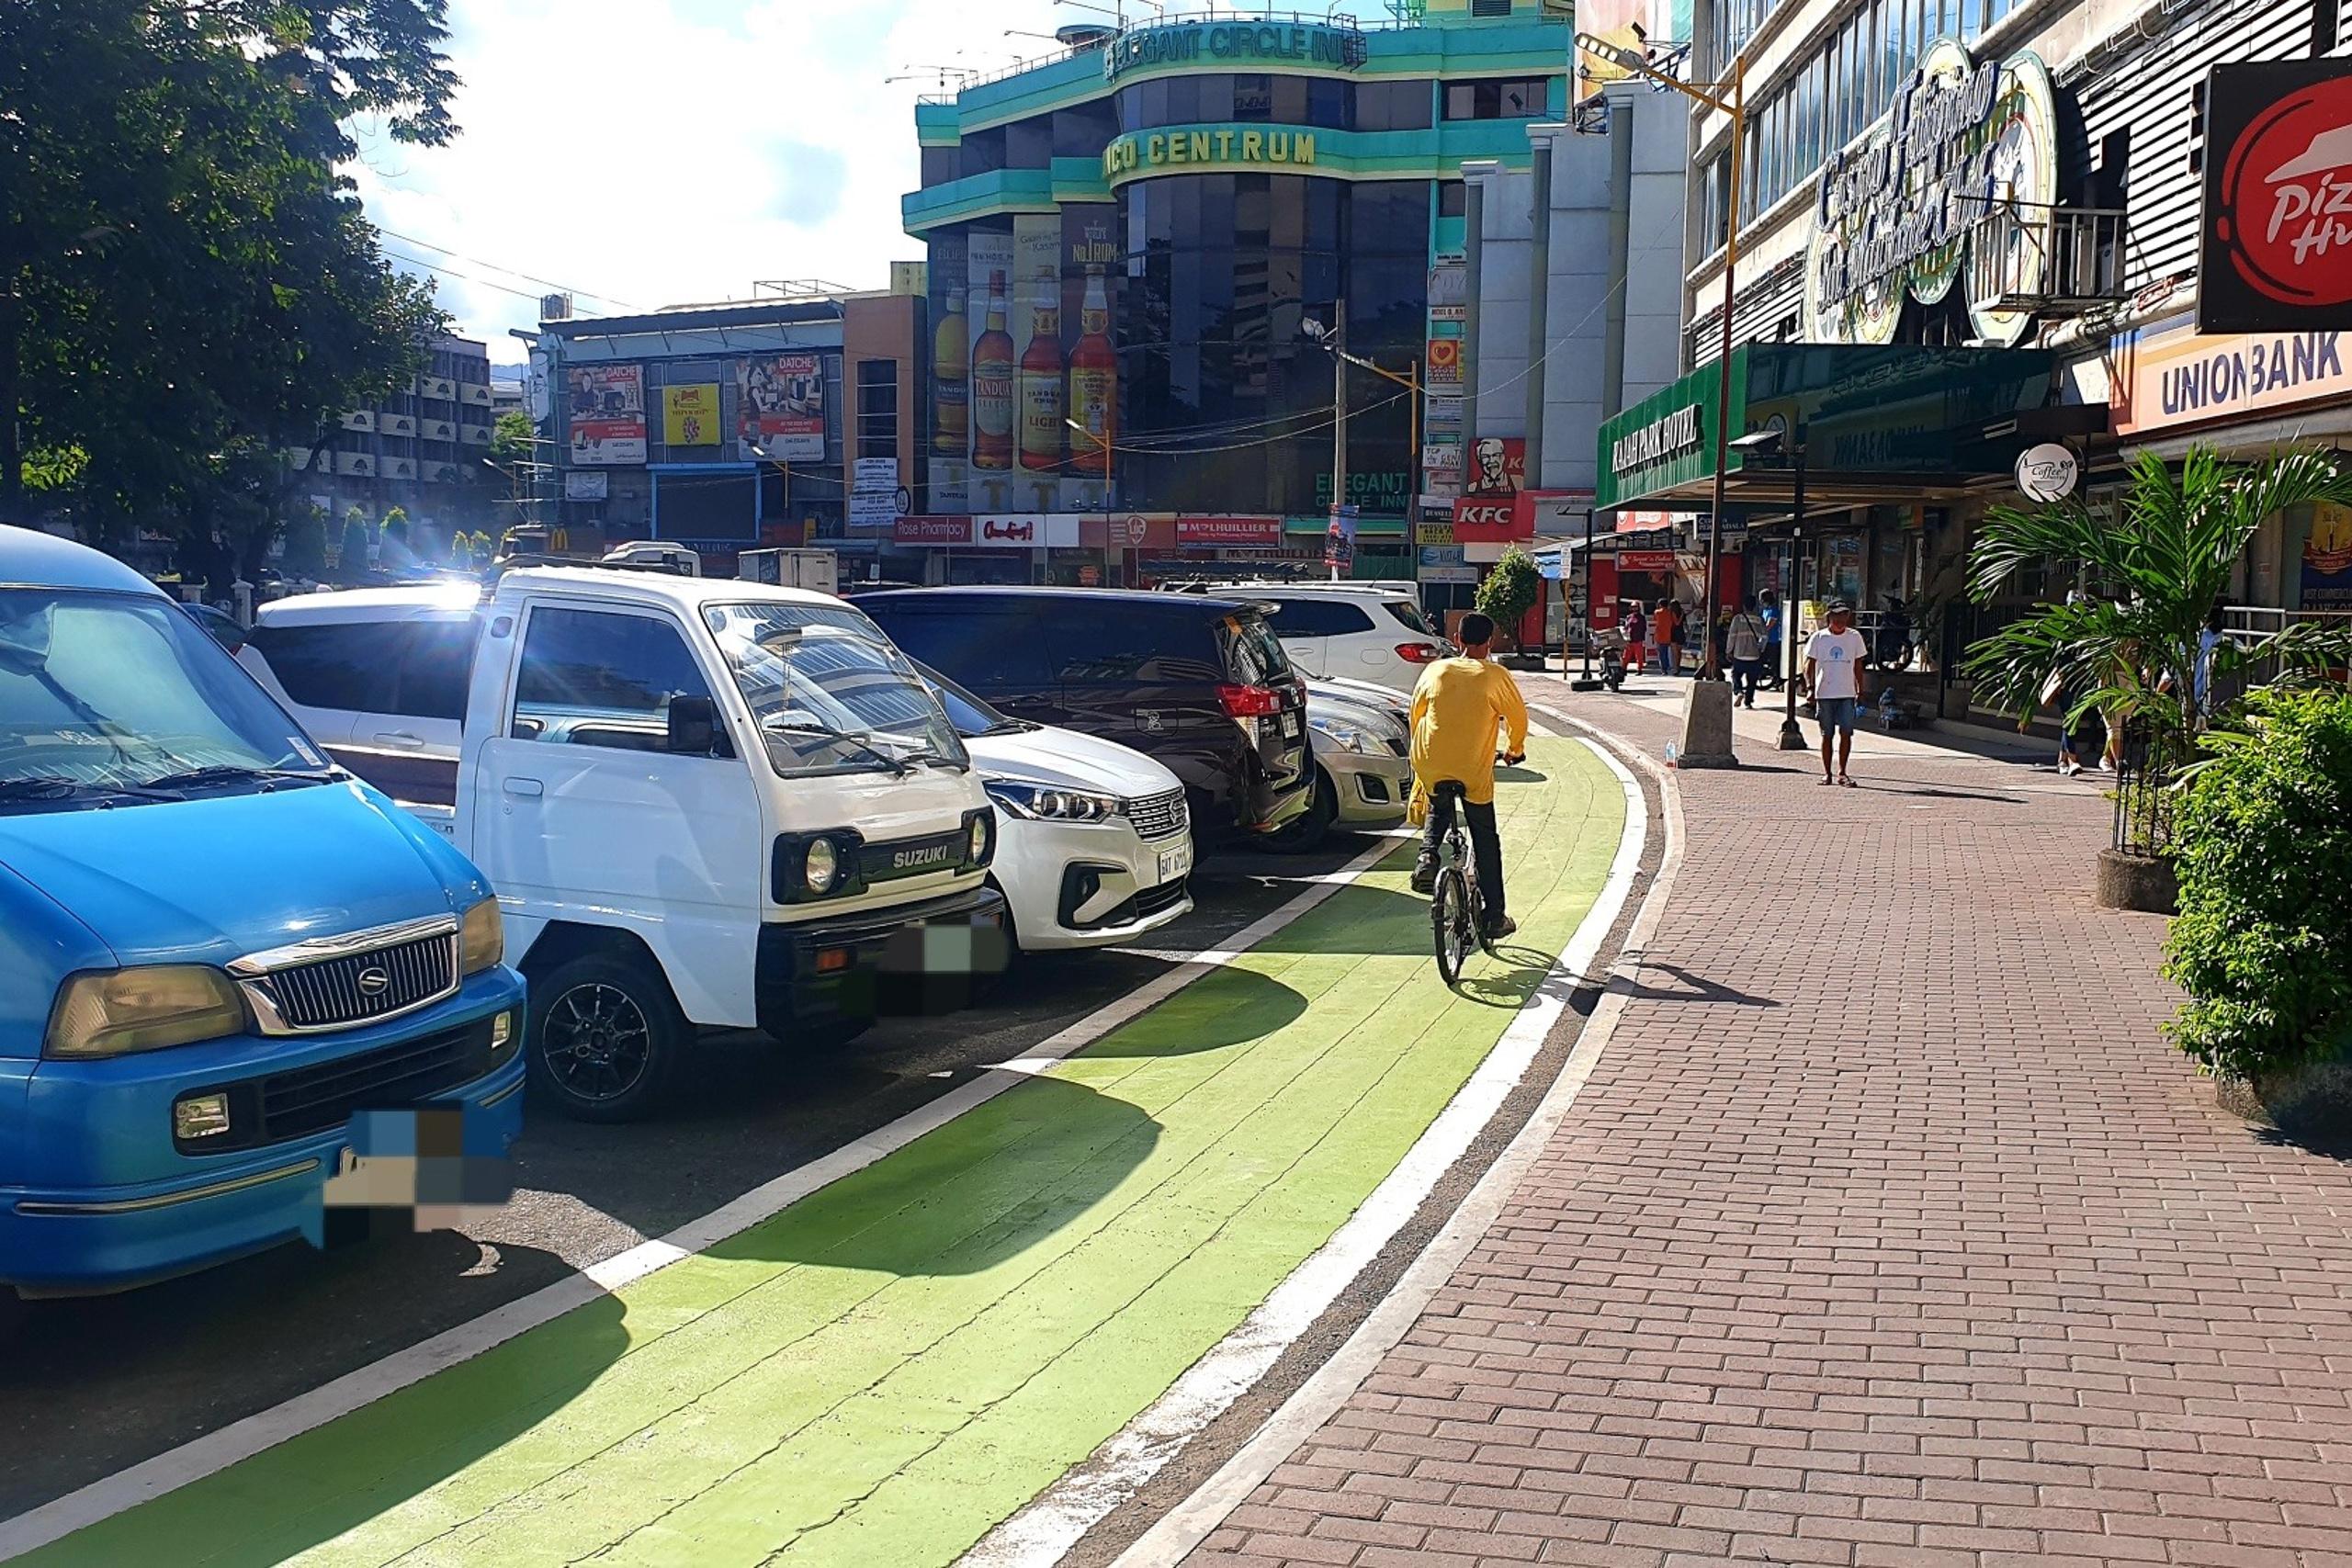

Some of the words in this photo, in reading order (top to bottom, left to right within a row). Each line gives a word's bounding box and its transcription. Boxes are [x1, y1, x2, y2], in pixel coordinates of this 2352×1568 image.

[1114, 27, 1203, 72] ELEGANT
[1209, 27, 1306, 60] CIRCLE
[1148, 130, 1315, 164] CENTRUM
[2162, 330, 2343, 415] UNIONBANK
[1639, 419, 1663, 460] PARK
[1663, 403, 1697, 453] HOTEL
[1316, 472, 1408, 494] ELEGANT
[1316, 495, 1372, 508] CICLE
[1380, 494, 1407, 508] INN
[1458, 506, 1512, 524] KFC
[898, 521, 919, 535] Rose
[920, 521, 966, 538] Pharmacy
[893, 845, 948, 868] SUZUKI
